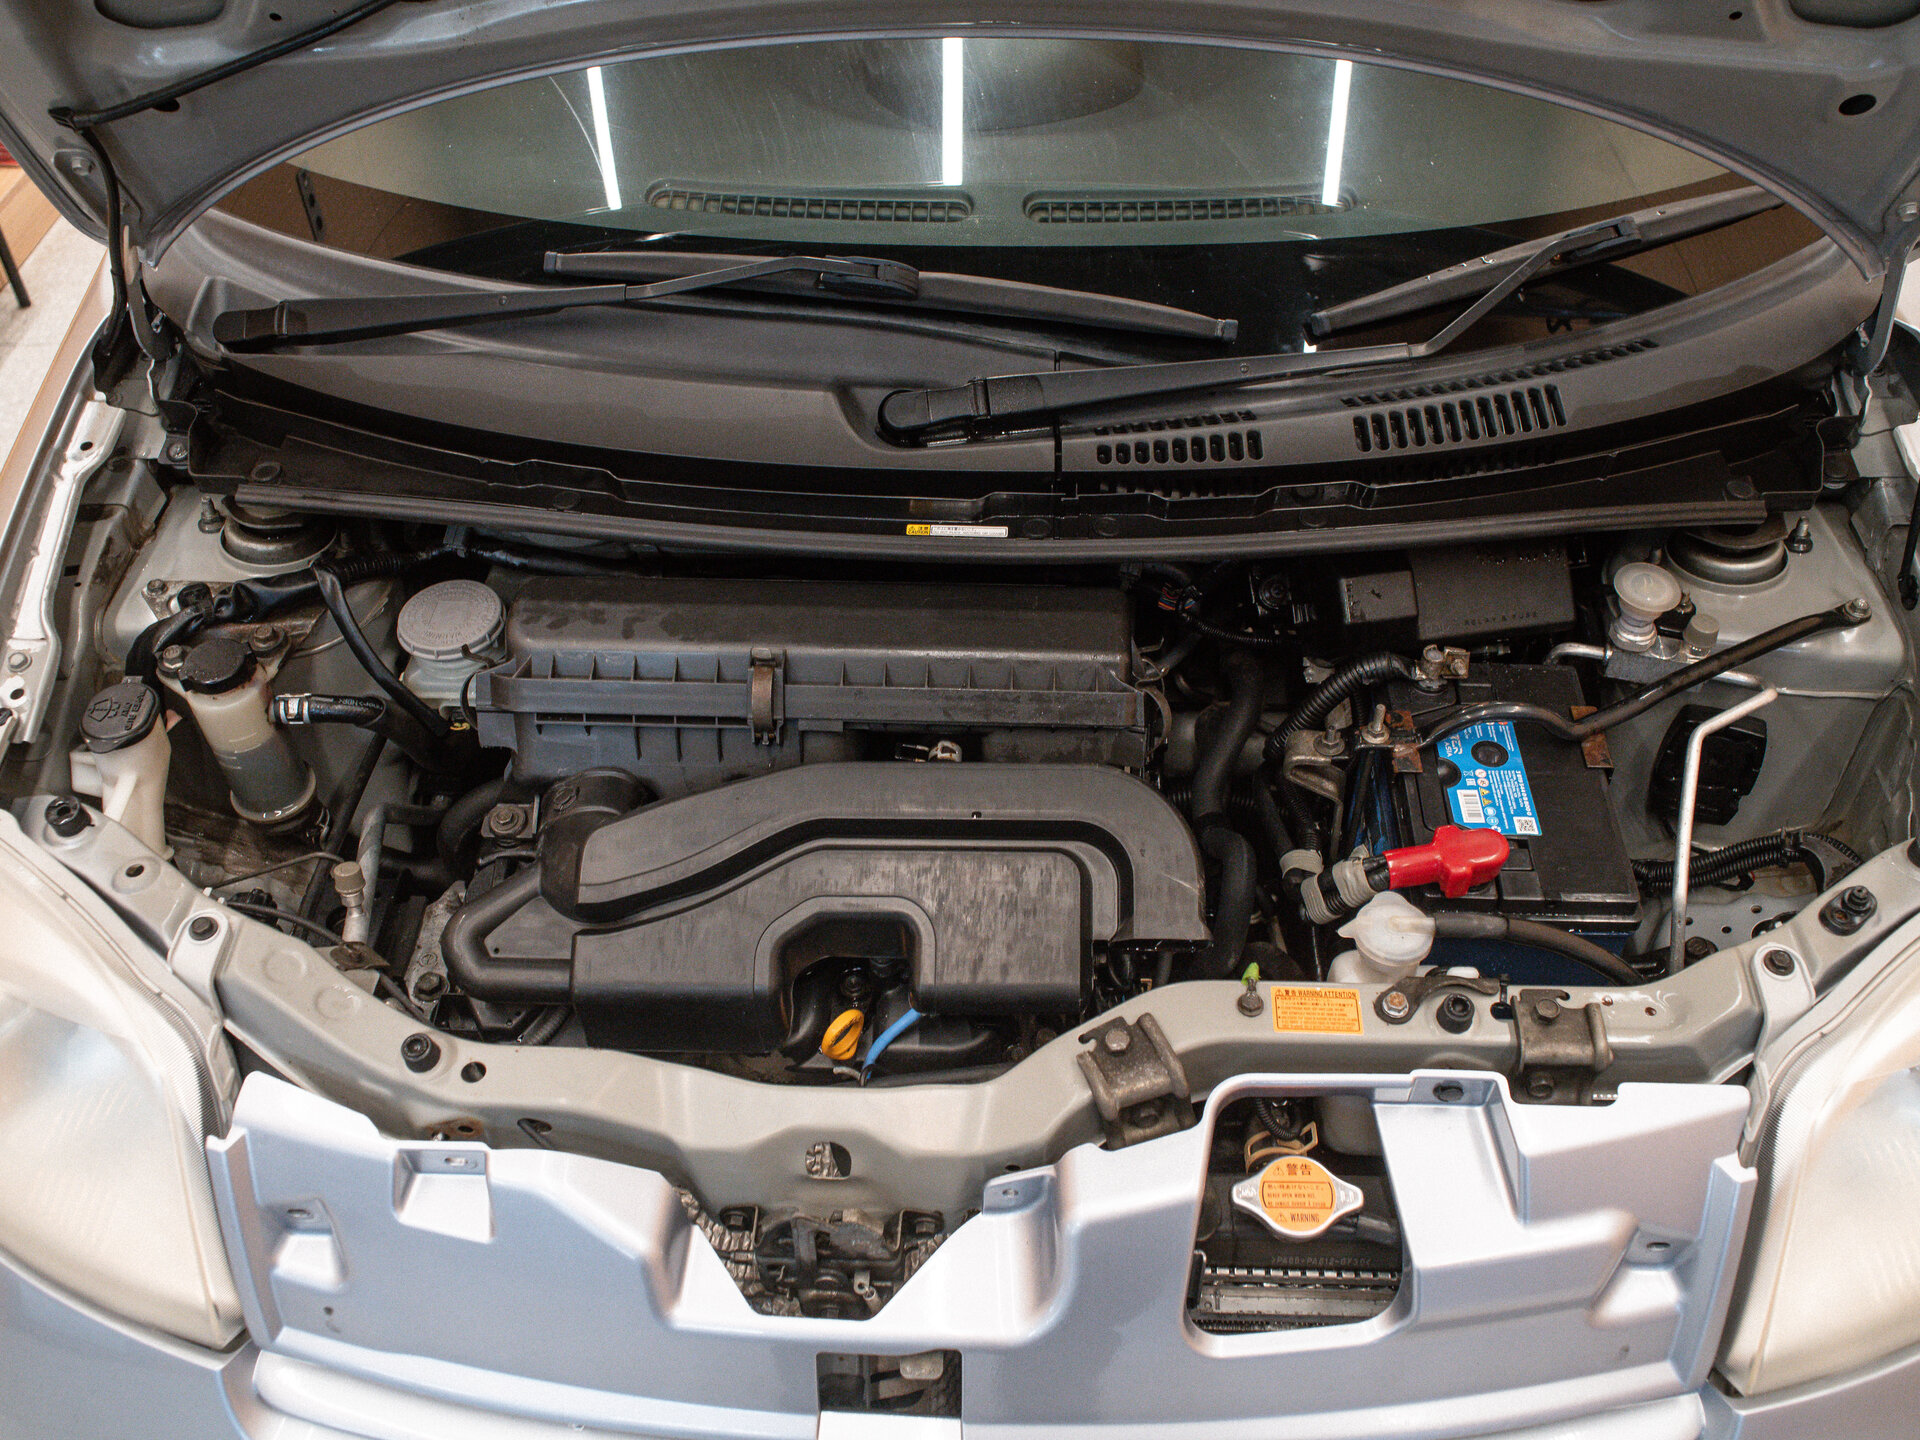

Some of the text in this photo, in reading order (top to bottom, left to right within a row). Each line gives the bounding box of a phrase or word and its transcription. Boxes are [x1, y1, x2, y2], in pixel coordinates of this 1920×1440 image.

[1324, 991, 1357, 999] ATTENTION
[1286, 1163, 1312, 1176] 警告
[1290, 1212, 1320, 1223] WARNING
